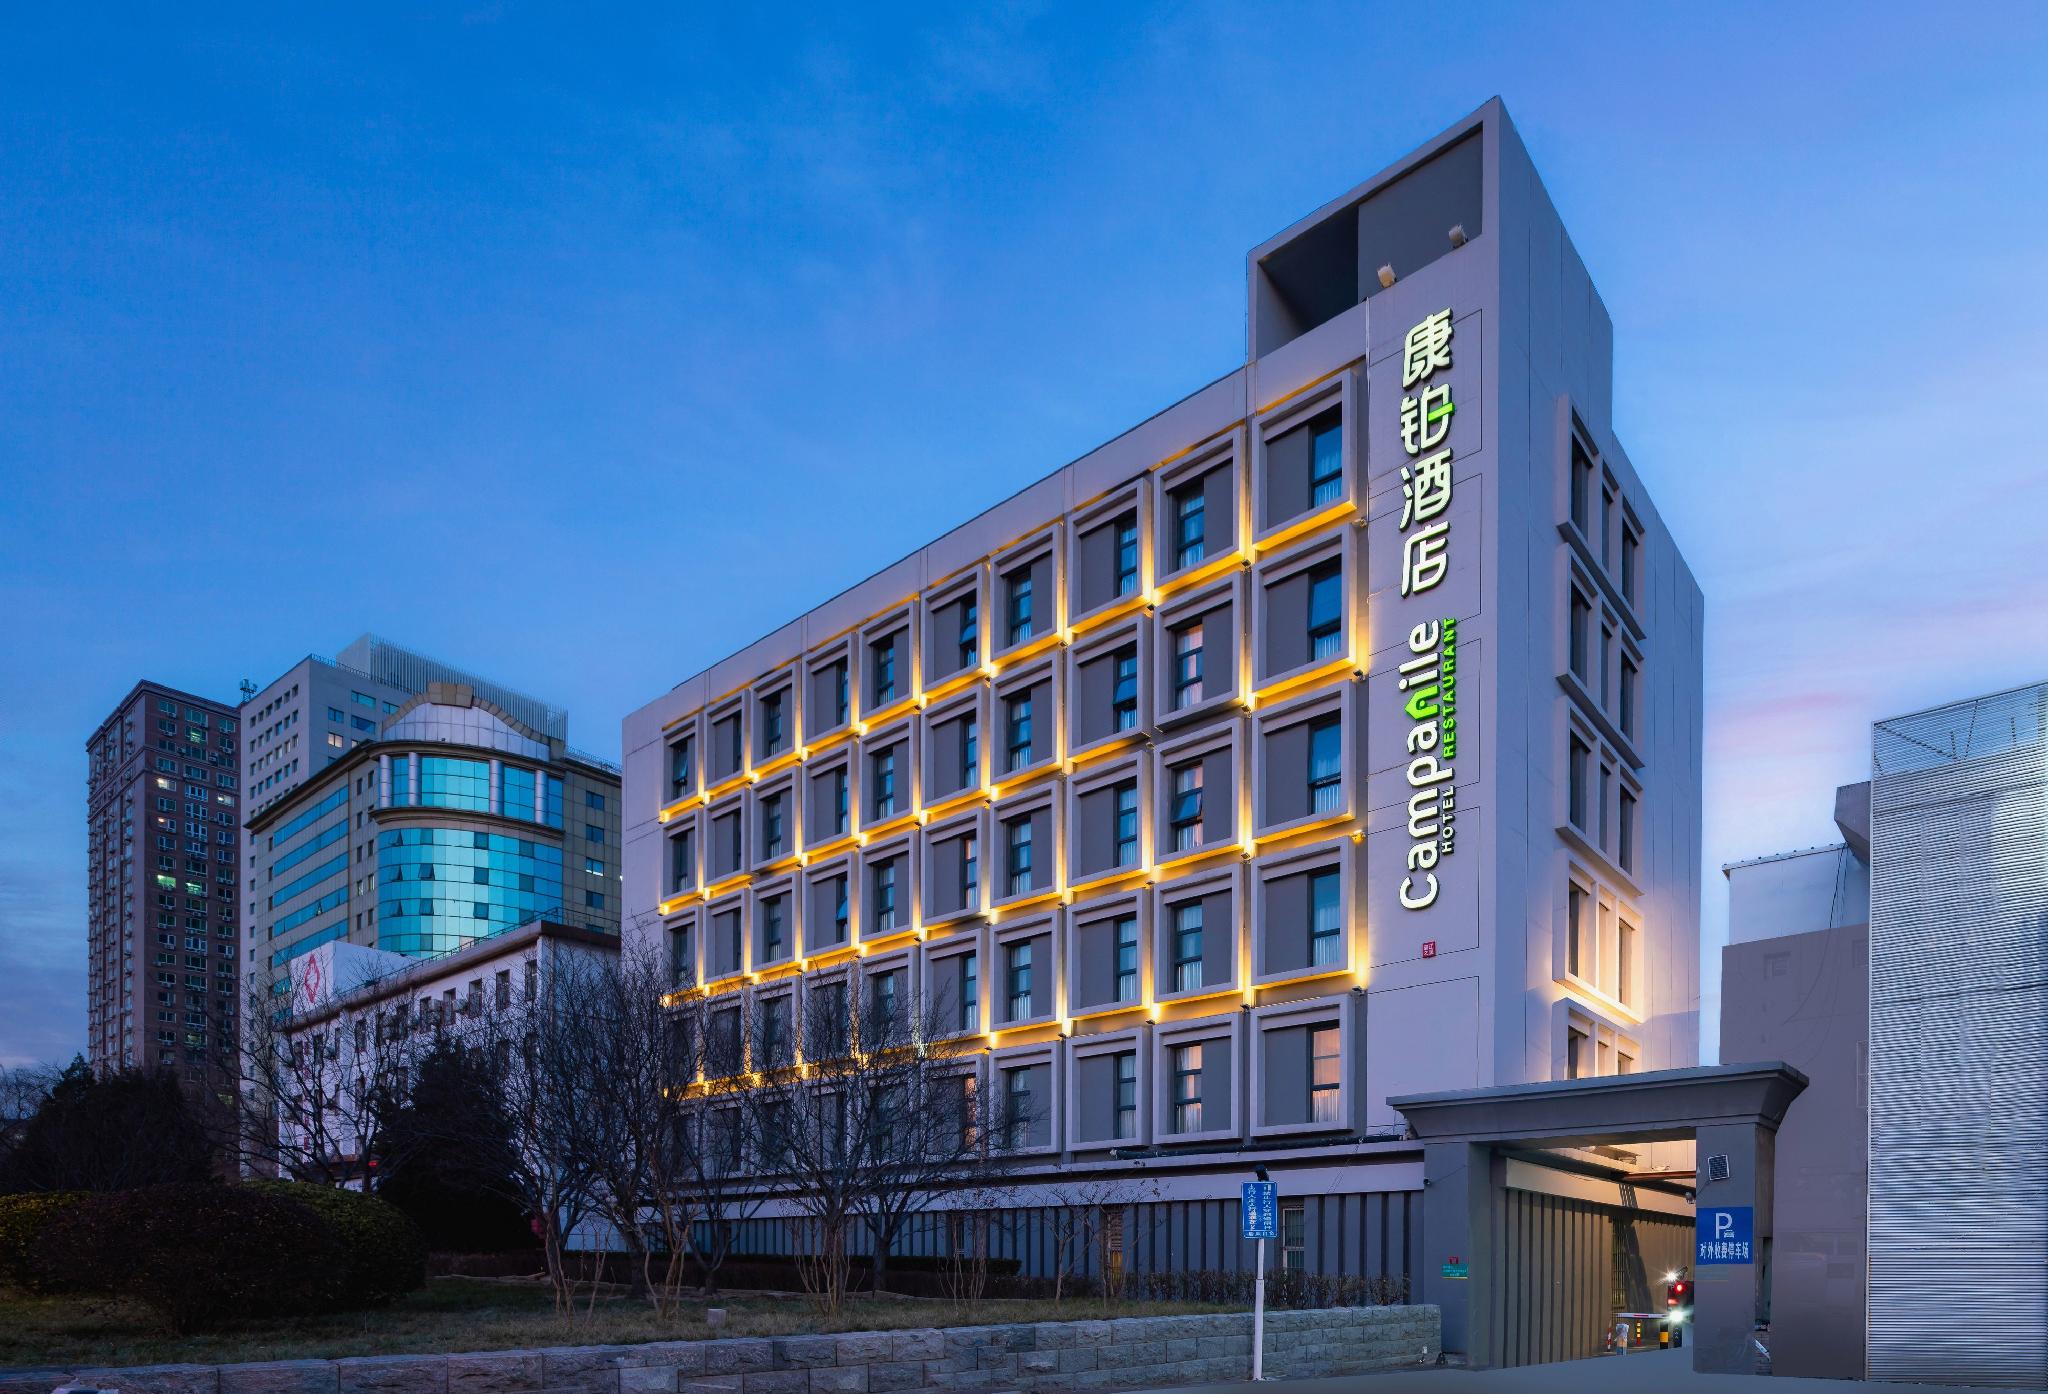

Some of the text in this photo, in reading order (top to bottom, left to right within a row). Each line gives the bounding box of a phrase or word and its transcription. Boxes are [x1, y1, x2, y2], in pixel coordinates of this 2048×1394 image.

[1400, 307, 1455, 598] 康铂酒店
[1443, 617, 1456, 760] RESTAURANT
[1400, 618, 1455, 911] Campanile
[1442, 784, 1455, 854] HOTEL
[1699, 1241, 1749, 1260] 对外收费停车场
[1715, 1212, 1733, 1240] P
